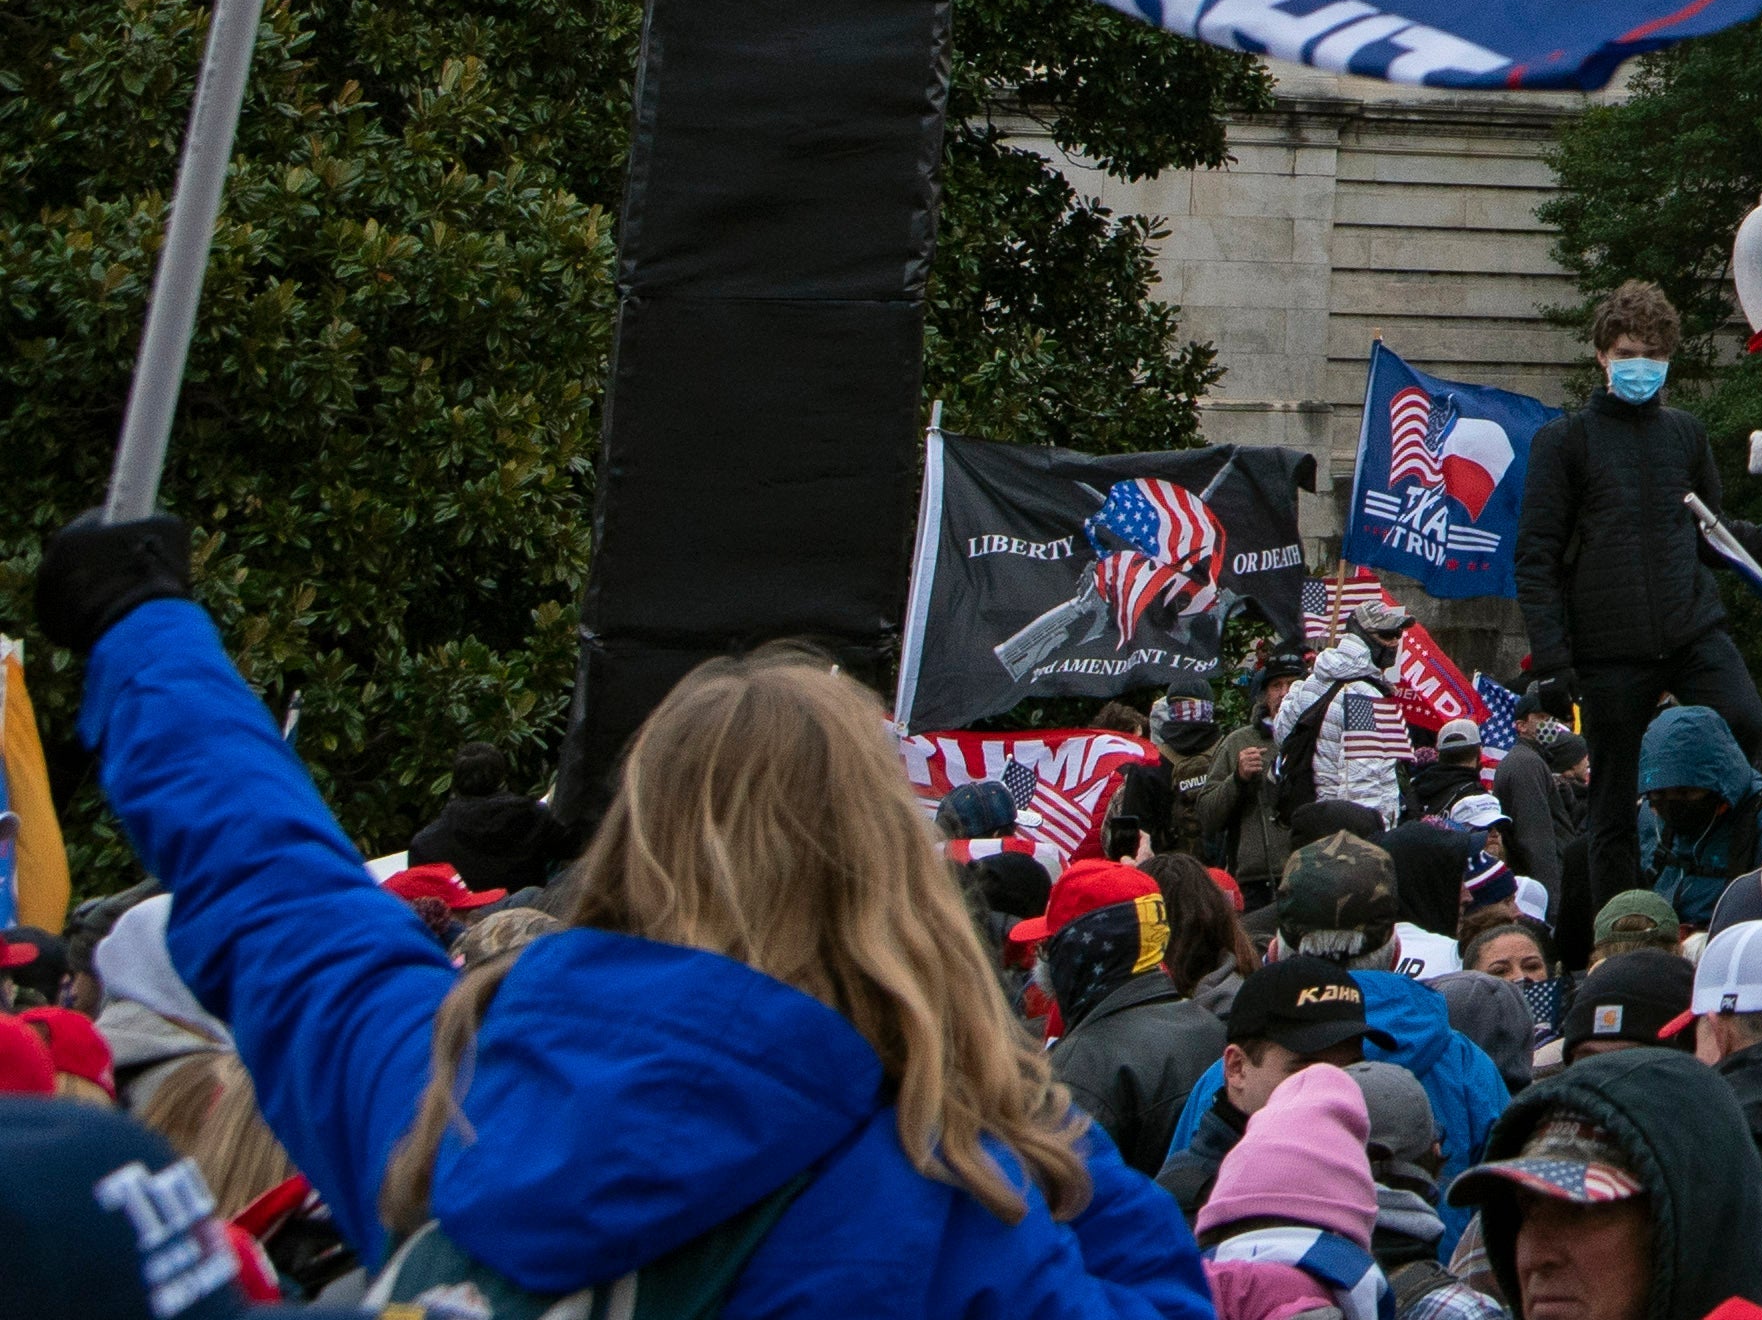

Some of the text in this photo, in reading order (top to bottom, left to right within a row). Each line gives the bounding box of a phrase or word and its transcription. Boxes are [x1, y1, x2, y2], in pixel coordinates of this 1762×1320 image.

[1397, 480, 1450, 543] TXA
[967, 534, 1303, 576] LIBERTY OR DEATH
[1171, 653, 1219, 675] 1789
[1296, 984, 1361, 1007] KAHR
